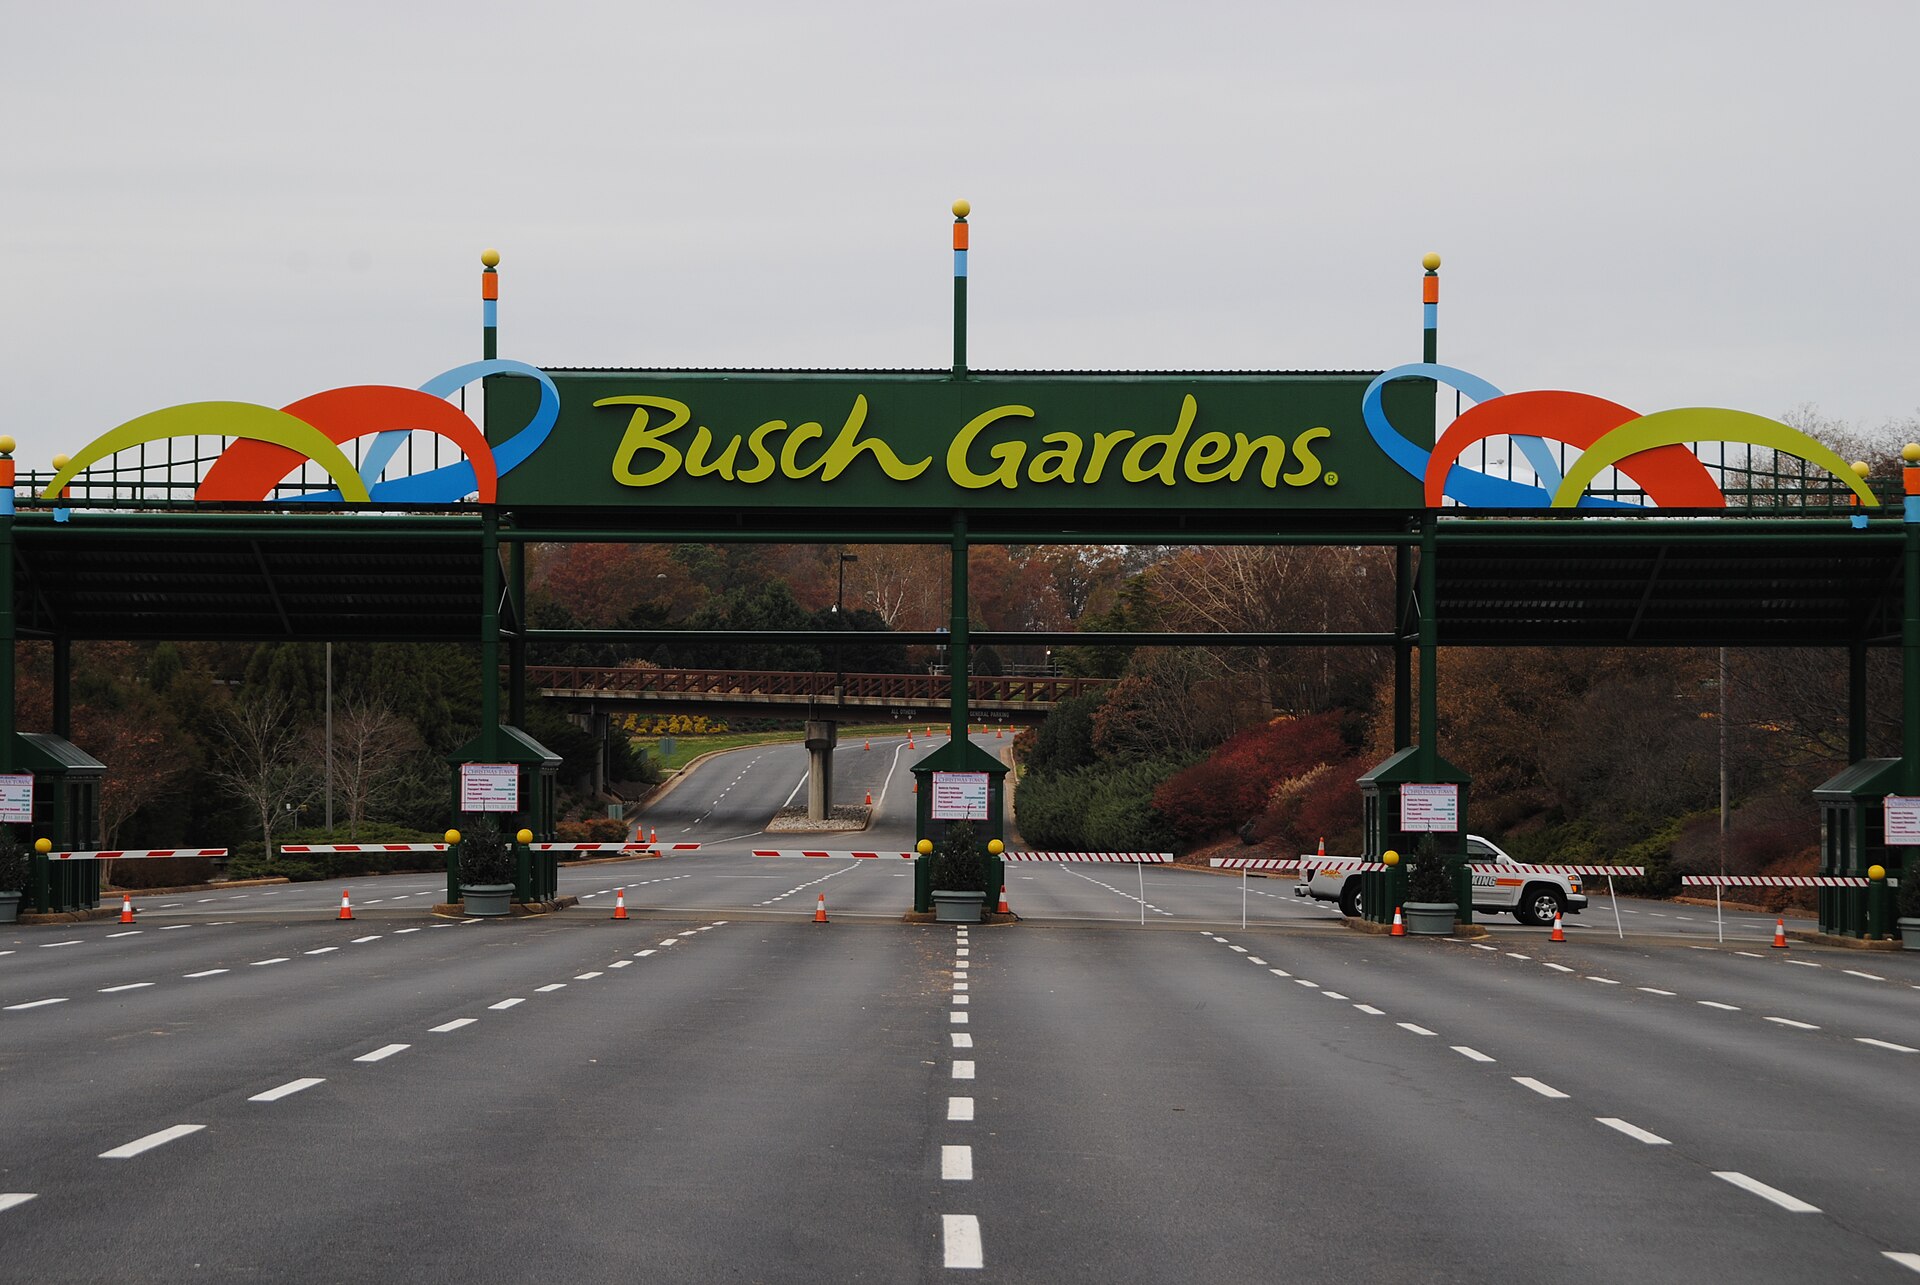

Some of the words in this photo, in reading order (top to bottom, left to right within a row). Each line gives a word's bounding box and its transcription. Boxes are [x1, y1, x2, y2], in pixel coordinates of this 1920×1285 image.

[593, 394, 932, 487] Busch
[947, 394, 1331, 489] Gardens
[1472, 876, 1496, 886] KING
